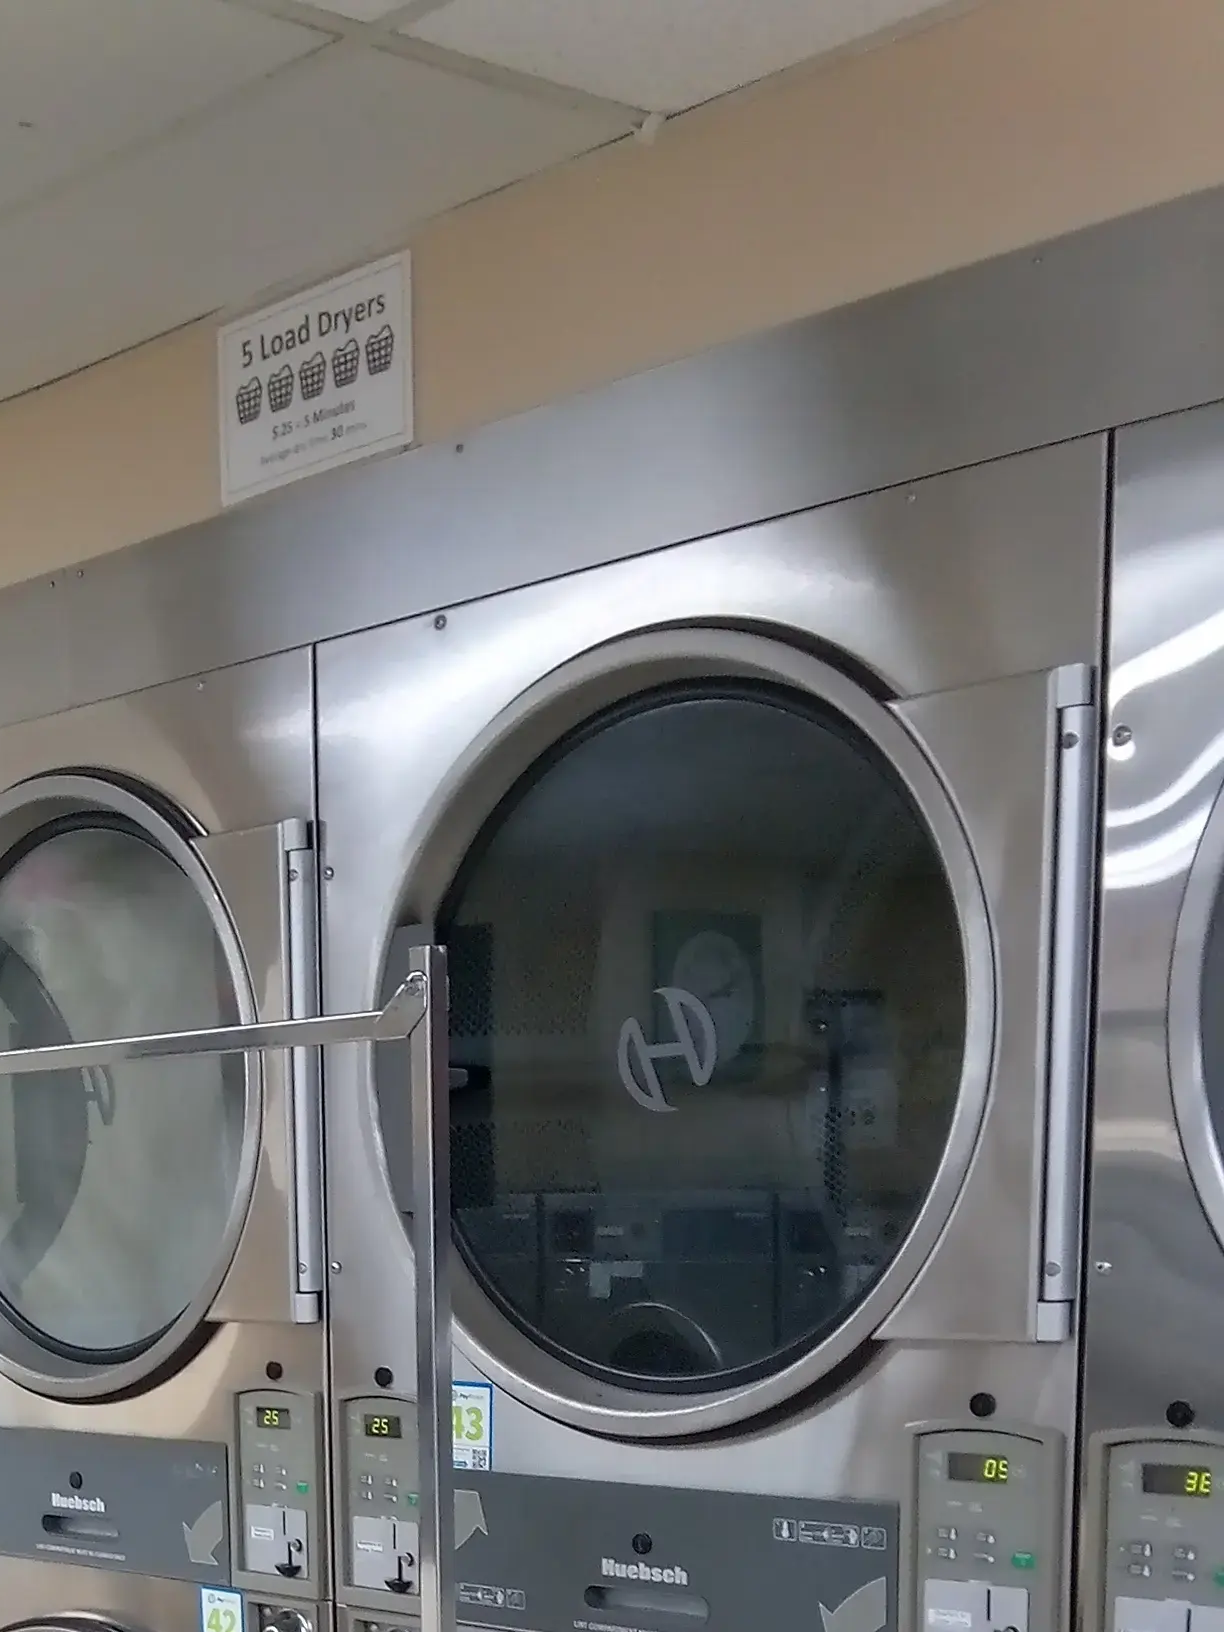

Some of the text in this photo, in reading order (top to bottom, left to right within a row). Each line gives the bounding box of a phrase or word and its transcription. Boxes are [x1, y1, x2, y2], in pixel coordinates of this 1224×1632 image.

[242, 294, 385, 368] 5 Load Dryers
[263, 1410, 279, 1426] 25
[371, 1418, 388, 1434] 25
[601, 1556, 689, 1586] Huebsch
